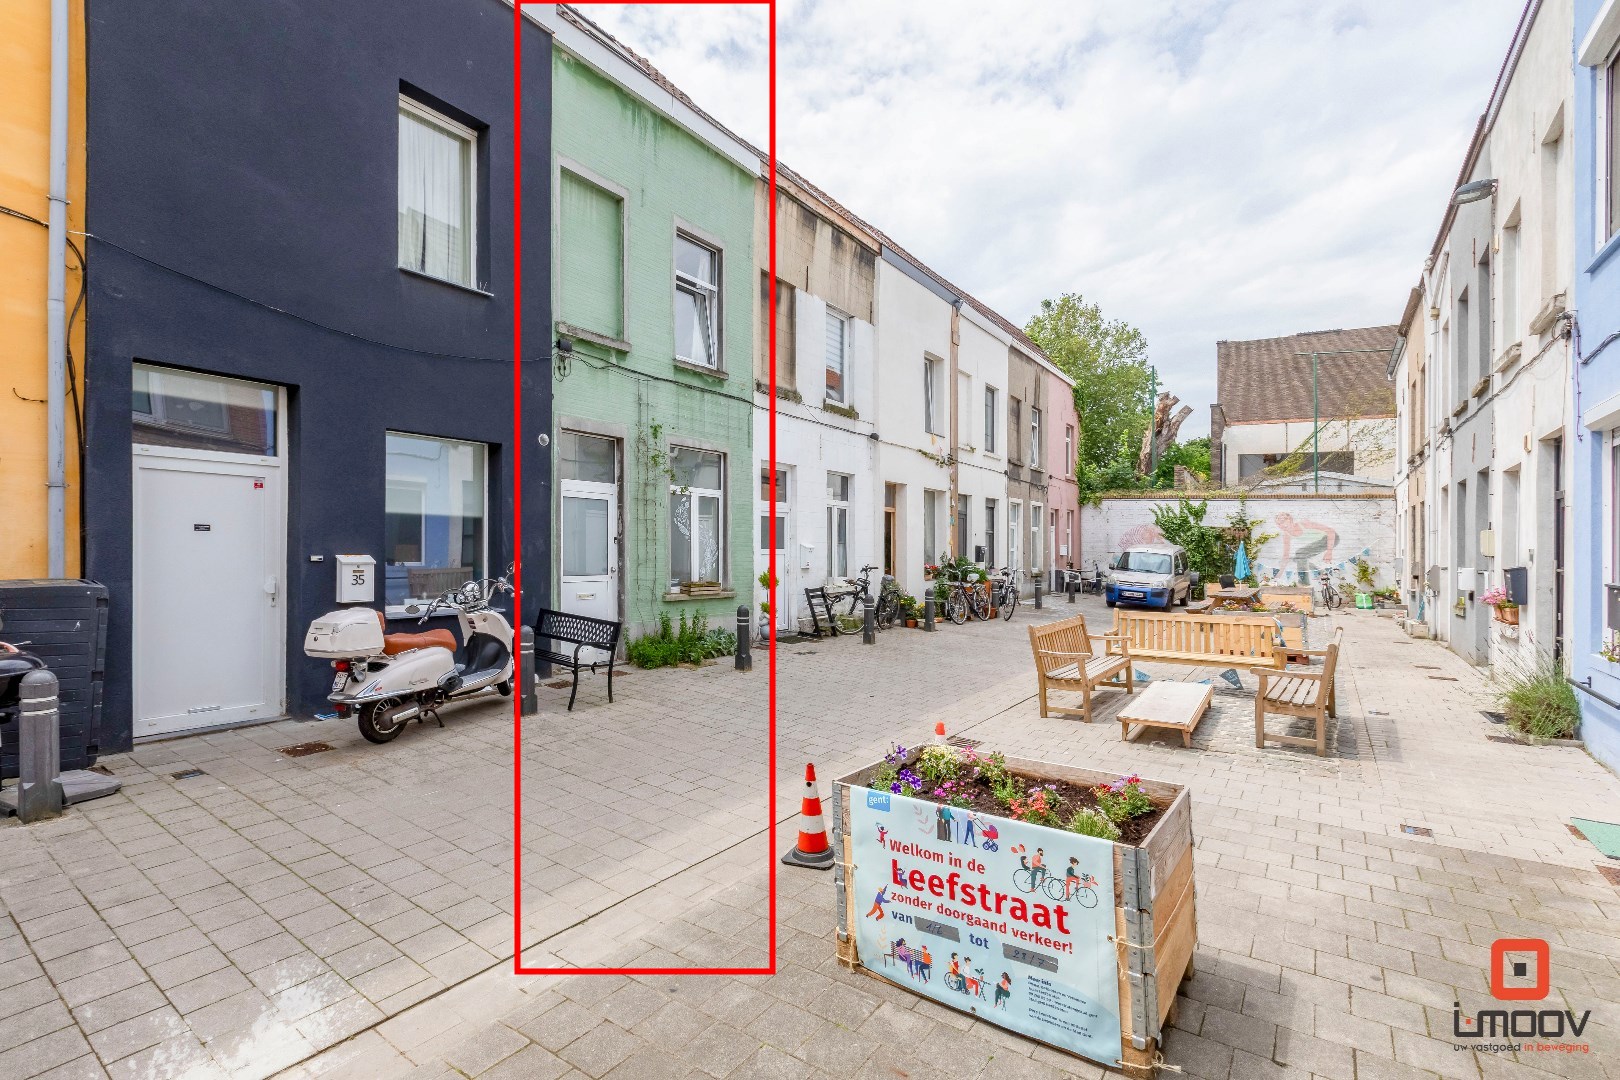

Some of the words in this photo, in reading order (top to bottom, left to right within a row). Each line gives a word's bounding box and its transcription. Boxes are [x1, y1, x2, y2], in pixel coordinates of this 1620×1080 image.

[351, 574, 365, 586] 35
[889, 838, 944, 864] Welkom
[948, 851, 962, 869] in
[967, 858, 986, 875] de
[891, 858, 1071, 935] Leefstraat
[891, 891, 933, 911] zonder
[936, 902, 1007, 935] doorgaand
[1011, 927, 1073, 955] verkeer!
[891, 910, 913, 925] van
[968, 932, 990, 950] tot
